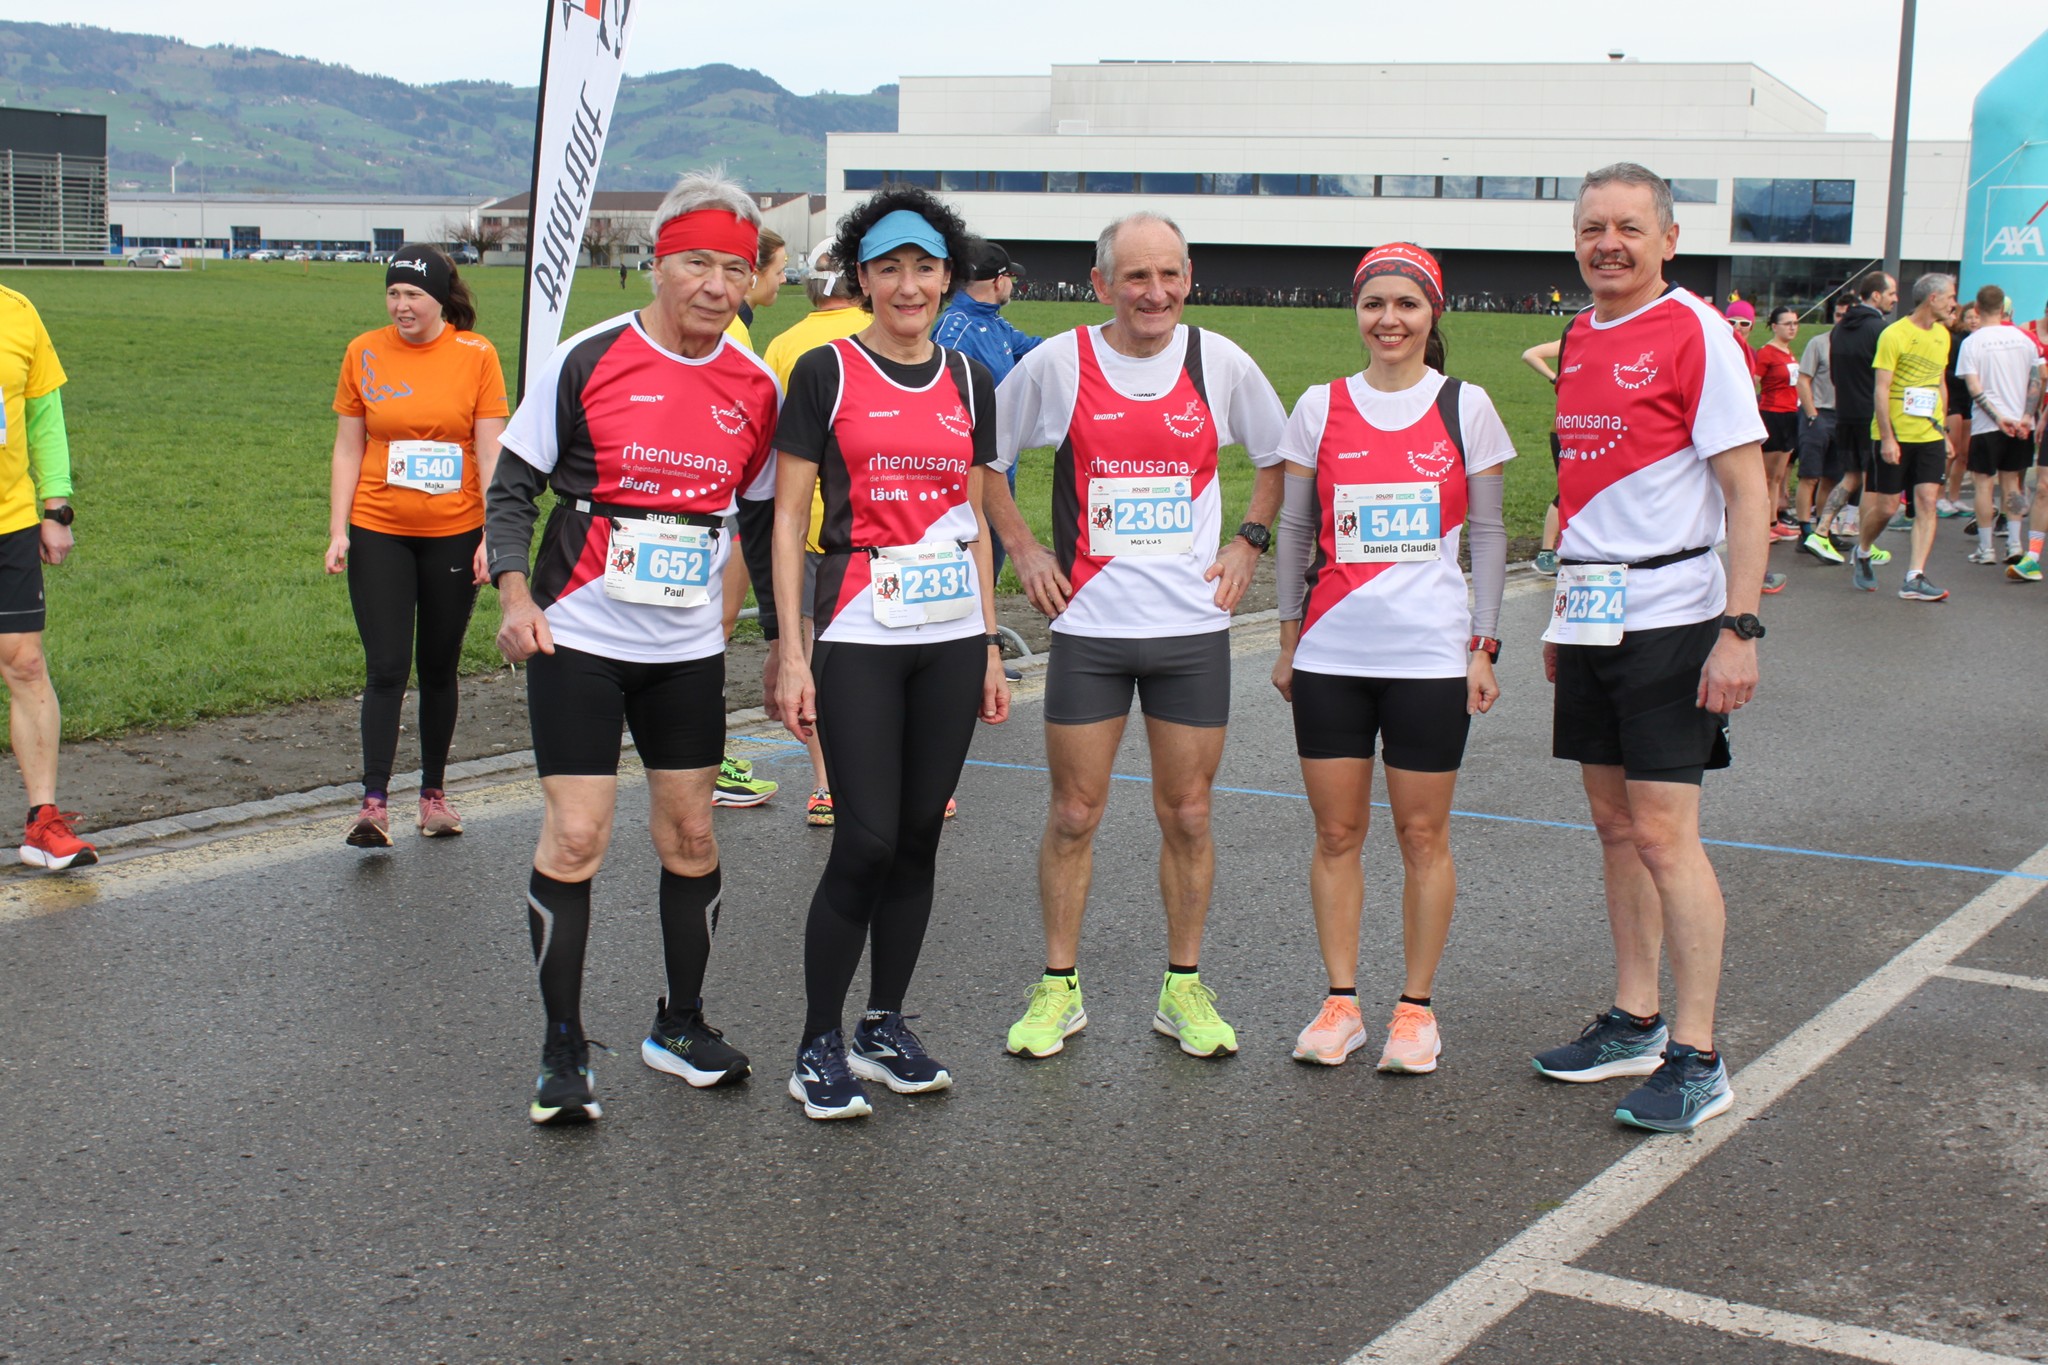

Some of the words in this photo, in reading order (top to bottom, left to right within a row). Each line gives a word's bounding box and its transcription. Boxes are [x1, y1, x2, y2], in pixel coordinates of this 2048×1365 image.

[1984, 225, 2045, 256] AXA
[415, 457, 455, 478] 540
[425, 482, 444, 490] Majka
[619, 476, 660, 495] läuft!
[870, 488, 909, 501] läuft!
[1117, 500, 1191, 530] 2360
[1371, 508, 1430, 538] 544
[1363, 544, 1398, 554] Daniela
[1401, 542, 1436, 552] Claudia
[649, 548, 703, 582] 652
[664, 586, 685, 597] Paul
[904, 565, 969, 600] 2331
[1567, 590, 1624, 619] 2324
